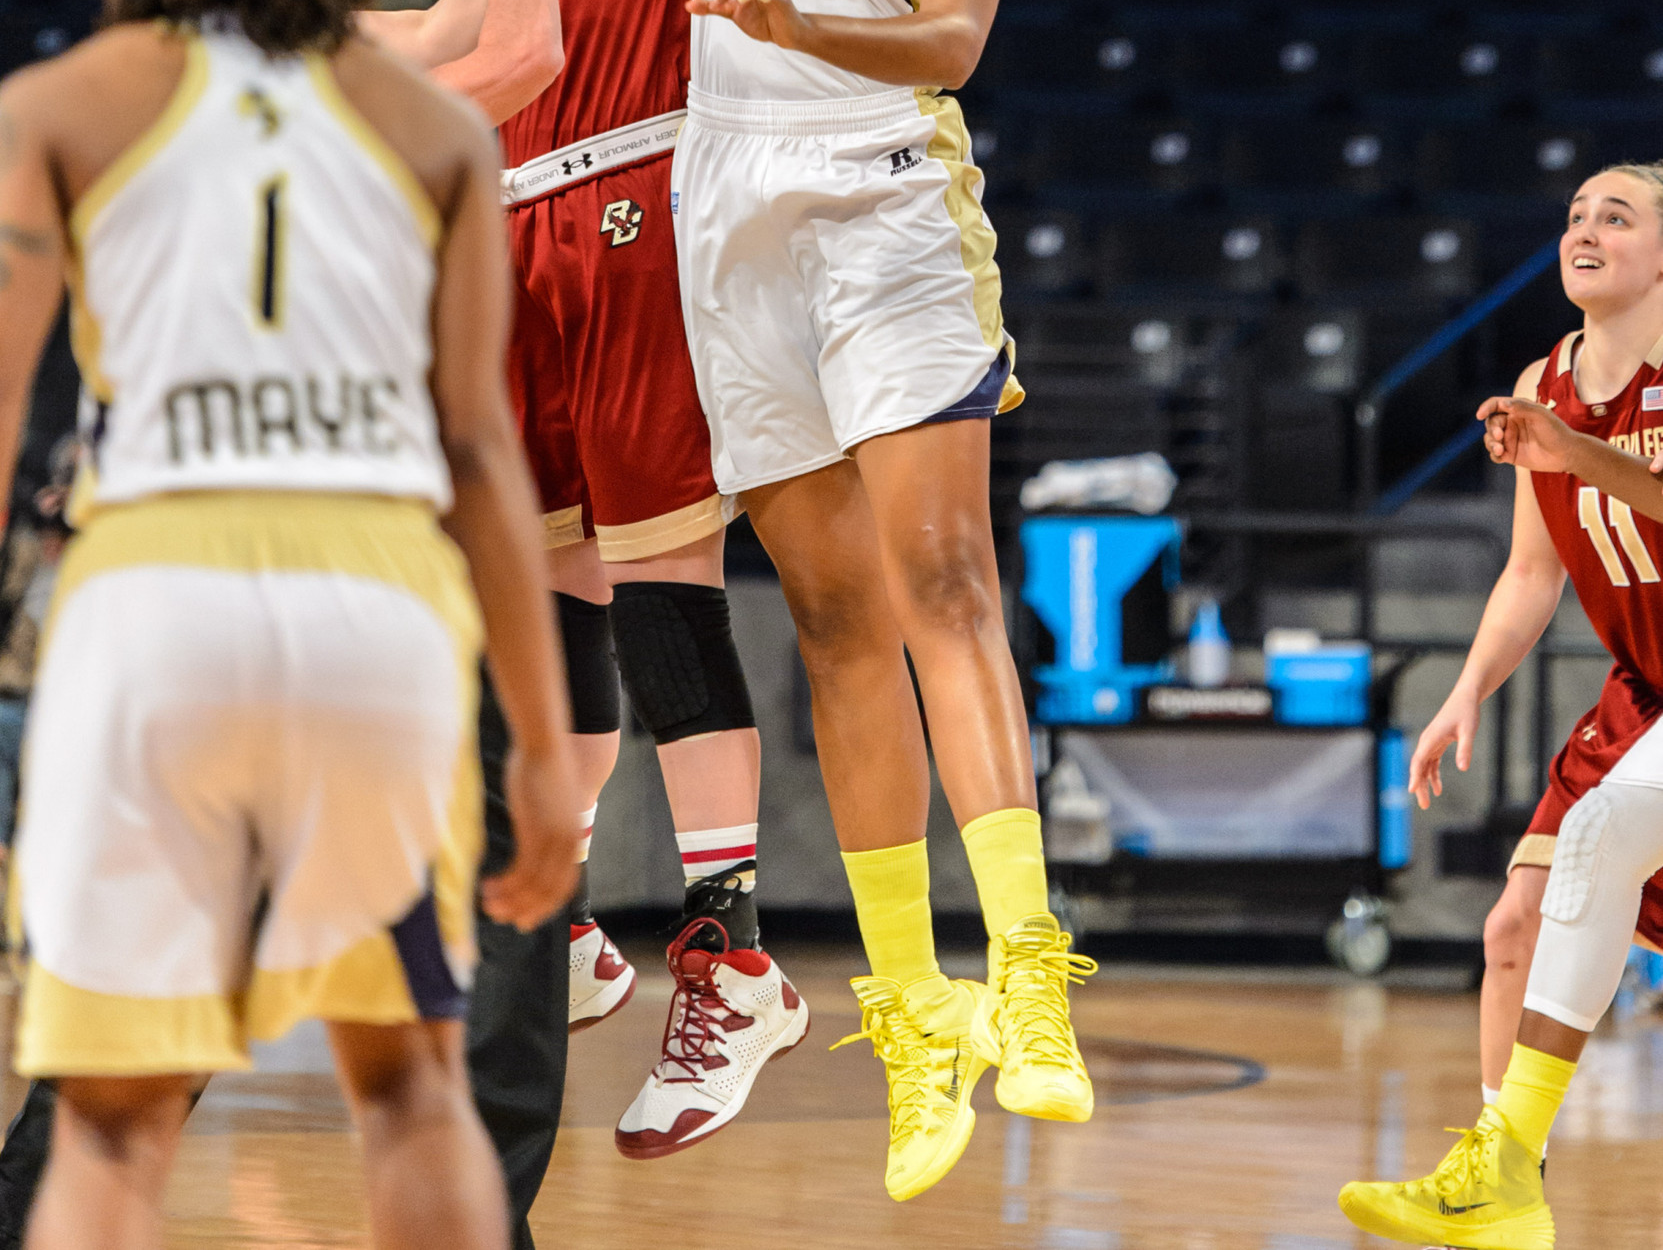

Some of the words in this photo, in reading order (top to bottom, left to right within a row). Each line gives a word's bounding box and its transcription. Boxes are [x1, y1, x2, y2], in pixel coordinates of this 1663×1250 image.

[527, 168, 559, 187] UNDER
[598, 136, 651, 160] ARMOUR
[890, 156, 923, 177] RUSSELL
[249, 172, 288, 332] 1
[164, 371, 399, 465] MAYE
[1578, 486, 1661, 587] 11
